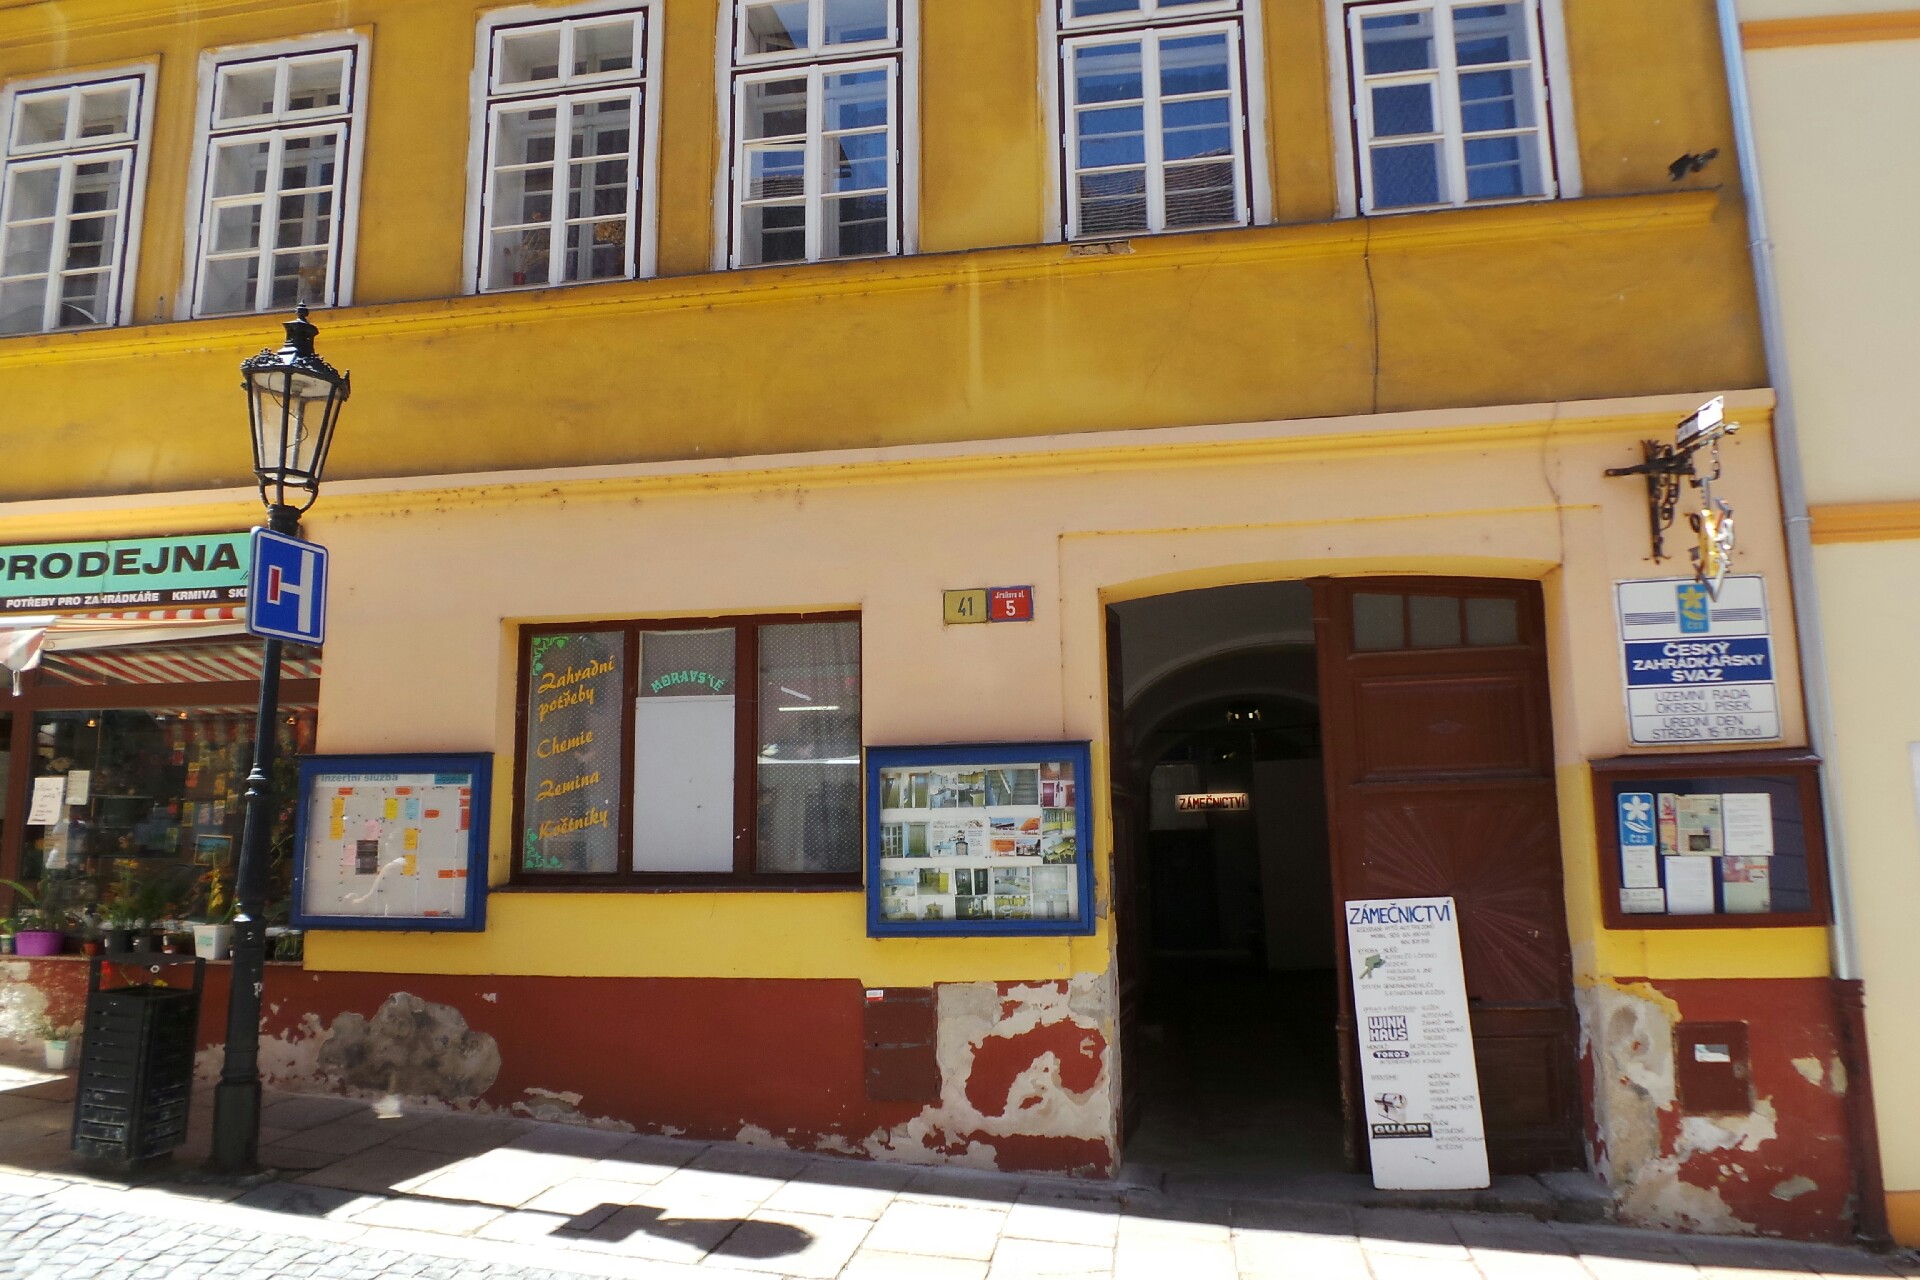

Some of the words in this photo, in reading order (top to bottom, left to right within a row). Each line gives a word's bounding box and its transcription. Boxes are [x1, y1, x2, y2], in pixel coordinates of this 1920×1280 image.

[0, 543, 240, 580] RODEJNA
[6, 597, 55, 608] POTŘEBY
[57, 596, 81, 606] PRO
[84, 592, 159, 605] ZAHRÁDKÁŘE
[172, 589, 217, 601] KRMIVA
[958, 597, 973, 616] 41
[1006, 600, 1016, 616] 5
[1663, 641, 1731, 657] ČESKÝ
[537, 654, 616, 694] Zahradní
[1671, 668, 1723, 682] SVAZ
[1712, 688, 1751, 700] RADA
[538, 684, 595, 722] potřeby
[1656, 701, 1708, 713] OKRESU
[1716, 714, 1744, 726] DEN
[537, 730, 594, 758] Chemie
[535, 771, 600, 801] Zemina
[1180, 794, 1246, 810] ZÁMEČNICTVÍ
[1349, 900, 1451, 925] ZÁMEČNICTVÍ
[1368, 1016, 1406, 1029] WINK
[1370, 1028, 1408, 1041] HAUS
[1373, 1123, 1429, 1134] GUARD
